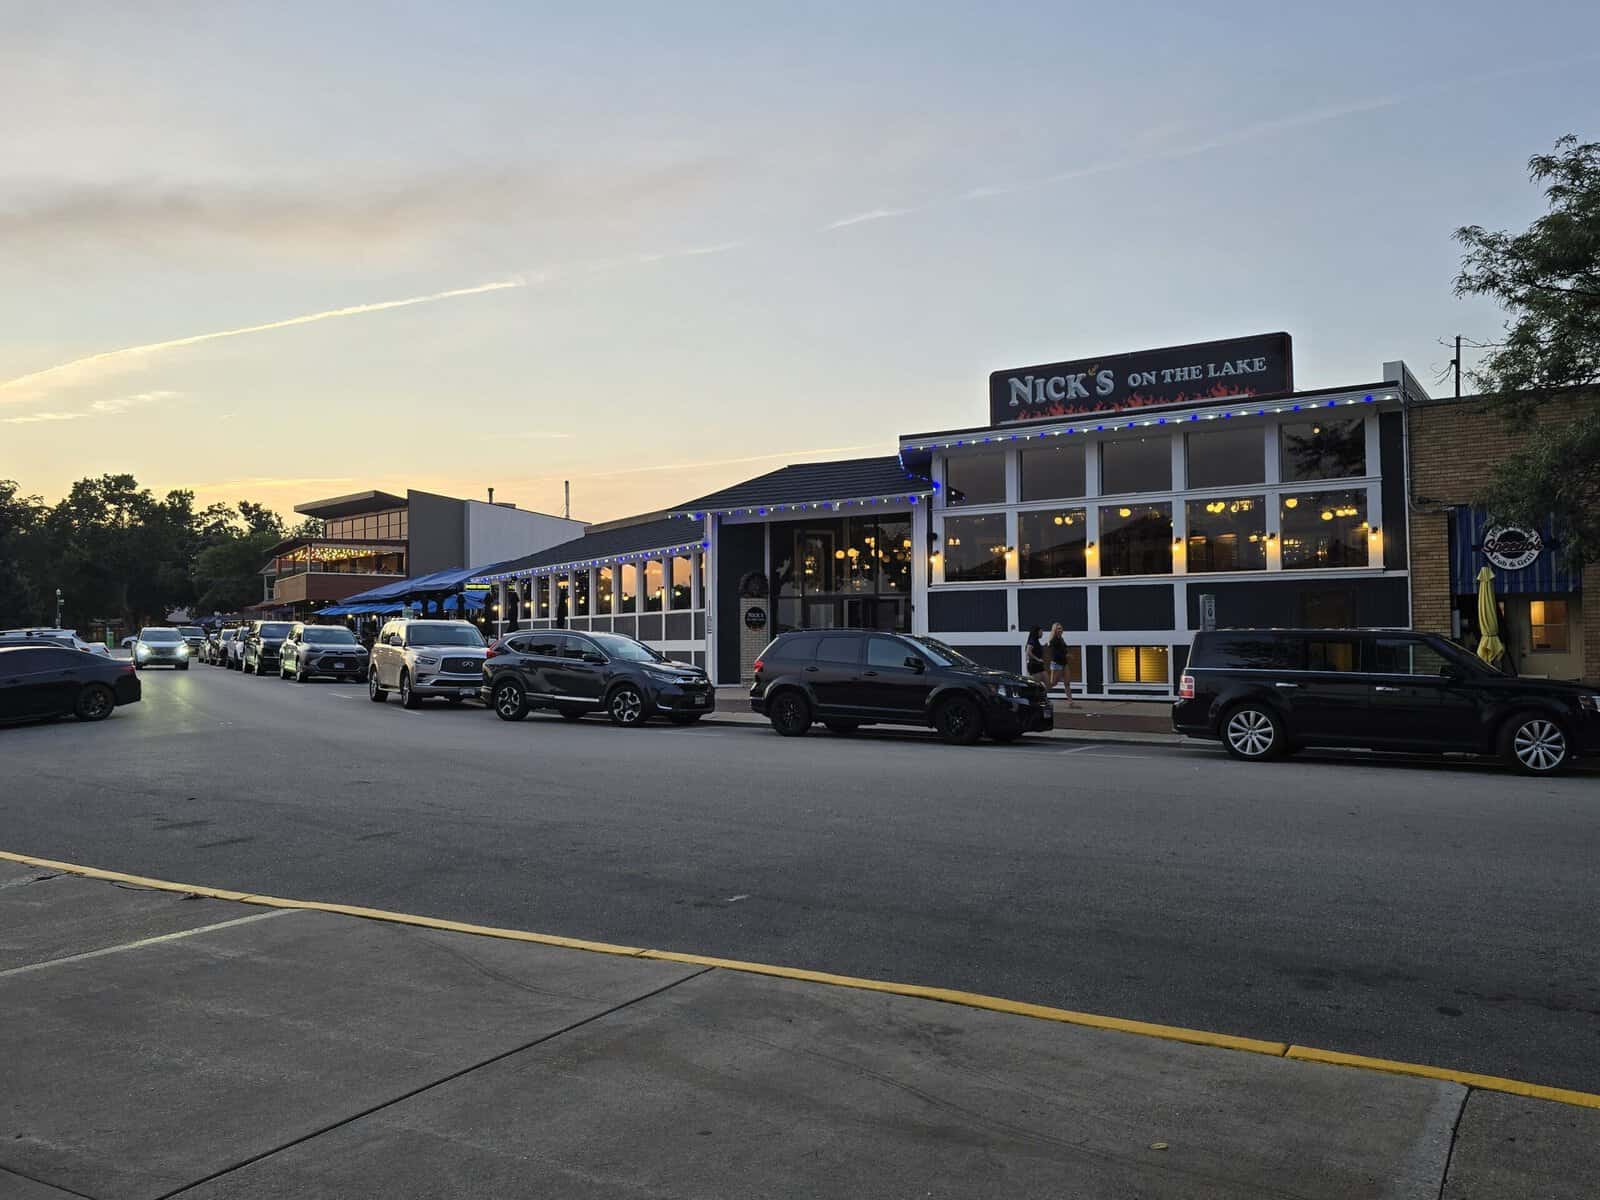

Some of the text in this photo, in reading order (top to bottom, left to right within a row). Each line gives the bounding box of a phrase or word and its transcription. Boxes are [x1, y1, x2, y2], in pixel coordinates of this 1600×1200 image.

[1008, 357, 1267, 406] NICK'S ON THE LAKE
